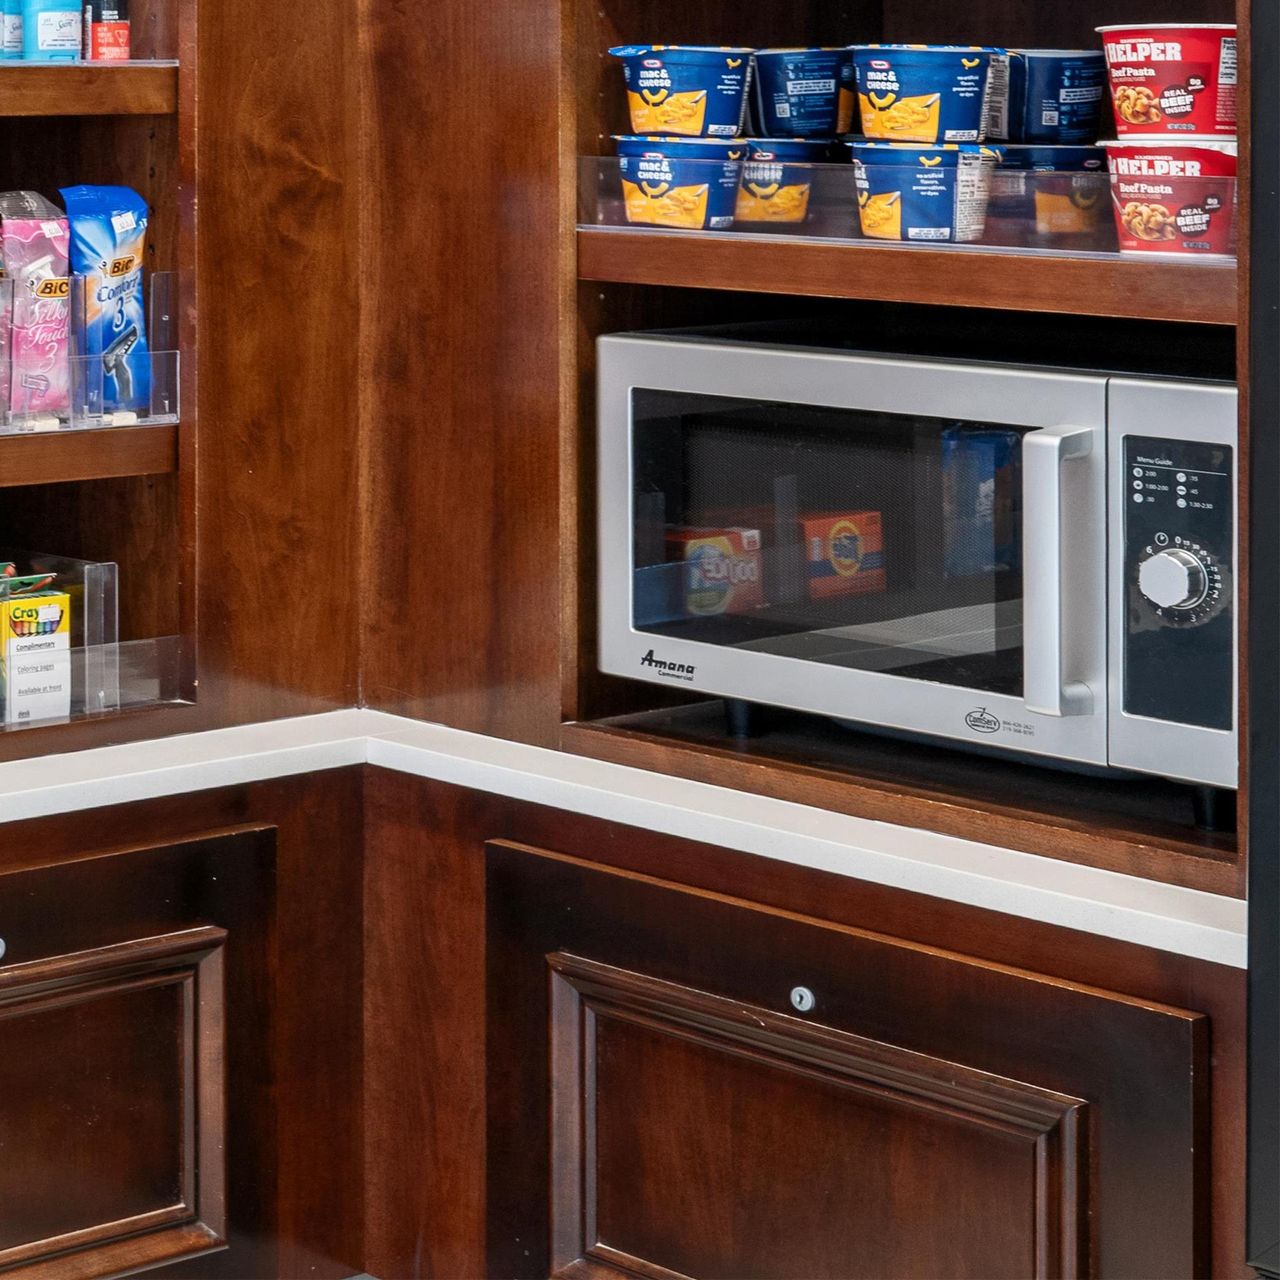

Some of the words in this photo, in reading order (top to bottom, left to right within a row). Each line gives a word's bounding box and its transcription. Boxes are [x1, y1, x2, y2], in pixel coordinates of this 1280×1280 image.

[1108, 42, 1182, 63] HELPER
[1160, 95, 1194, 107] BEEF
[1164, 89, 1187, 98] REAL
[1165, 106, 1192, 114] INSIDE
[1117, 158, 1200, 176] HELPER
[1120, 183, 1139, 194] Beef
[1140, 185, 1173, 195] Pasta
[97, 279, 139, 303] Comfort
[641, 649, 695, 674] Amana
